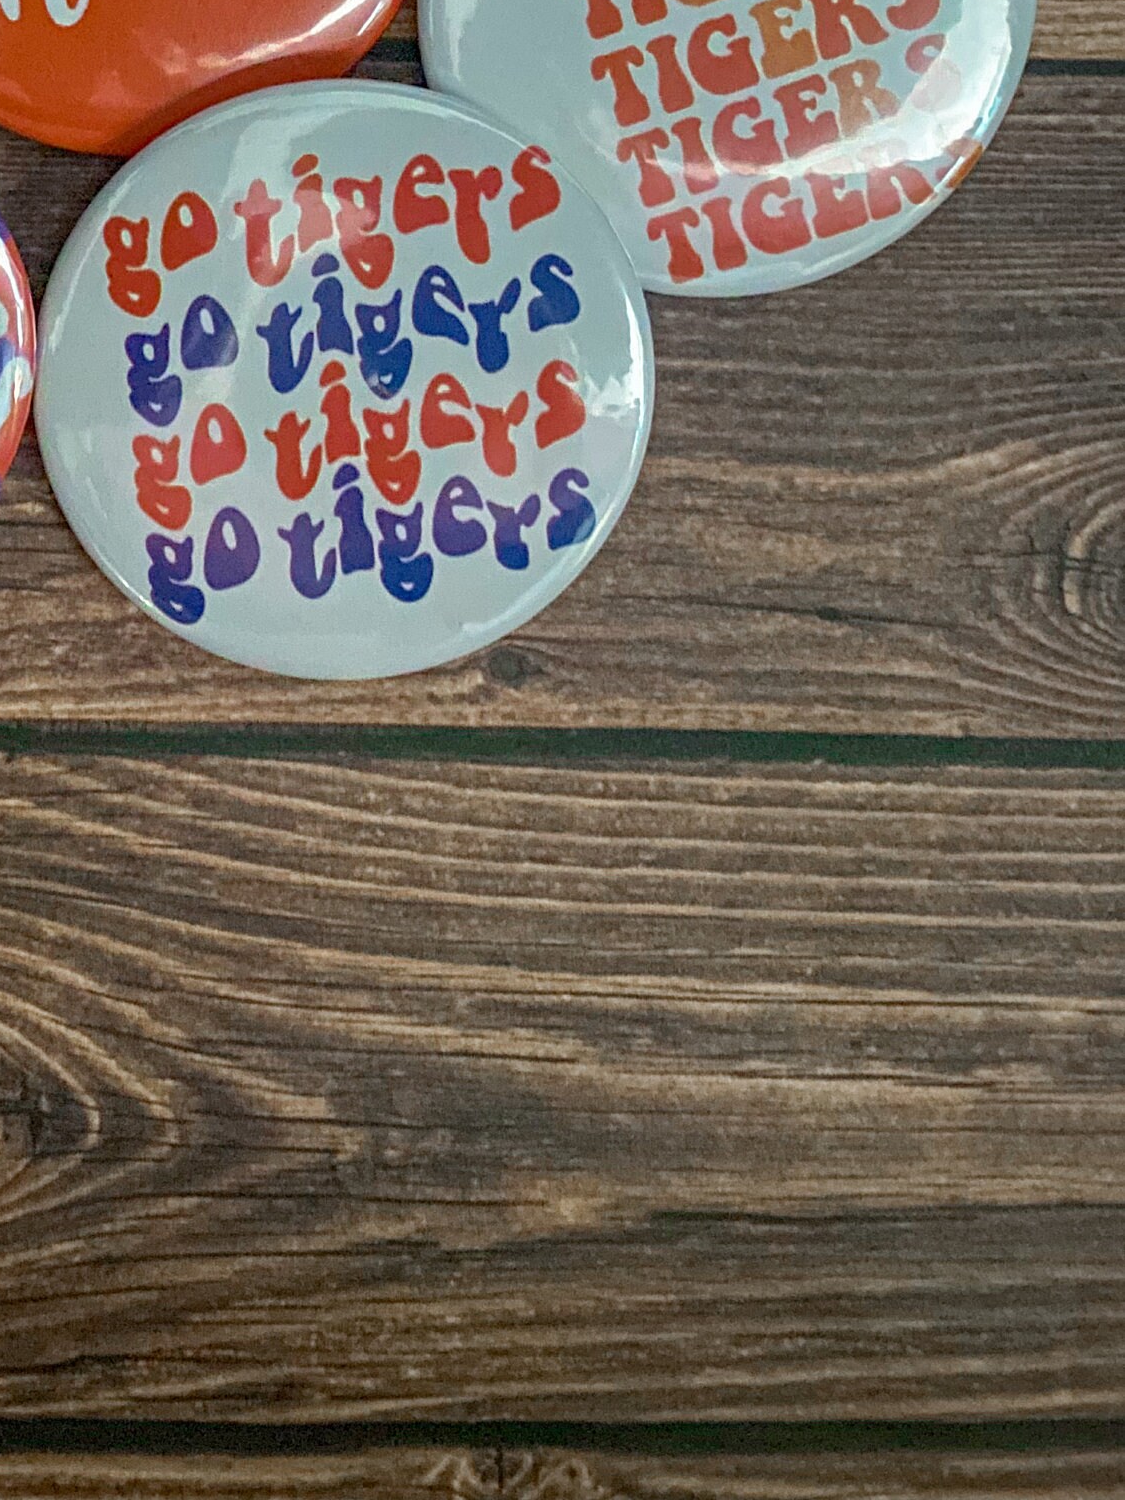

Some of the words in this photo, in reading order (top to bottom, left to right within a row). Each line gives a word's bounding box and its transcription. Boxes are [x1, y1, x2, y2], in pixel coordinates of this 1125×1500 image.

[102, 190, 219, 319] go
[233, 144, 562, 290] tigers
[646, 136, 983, 285] TIGER
[124, 294, 239, 427] go
[256, 252, 581, 401] tigers
[131, 402, 248, 532] go
[263, 358, 587, 506] tigers
[144, 505, 262, 626] go
[277, 462, 597, 603] tigers
